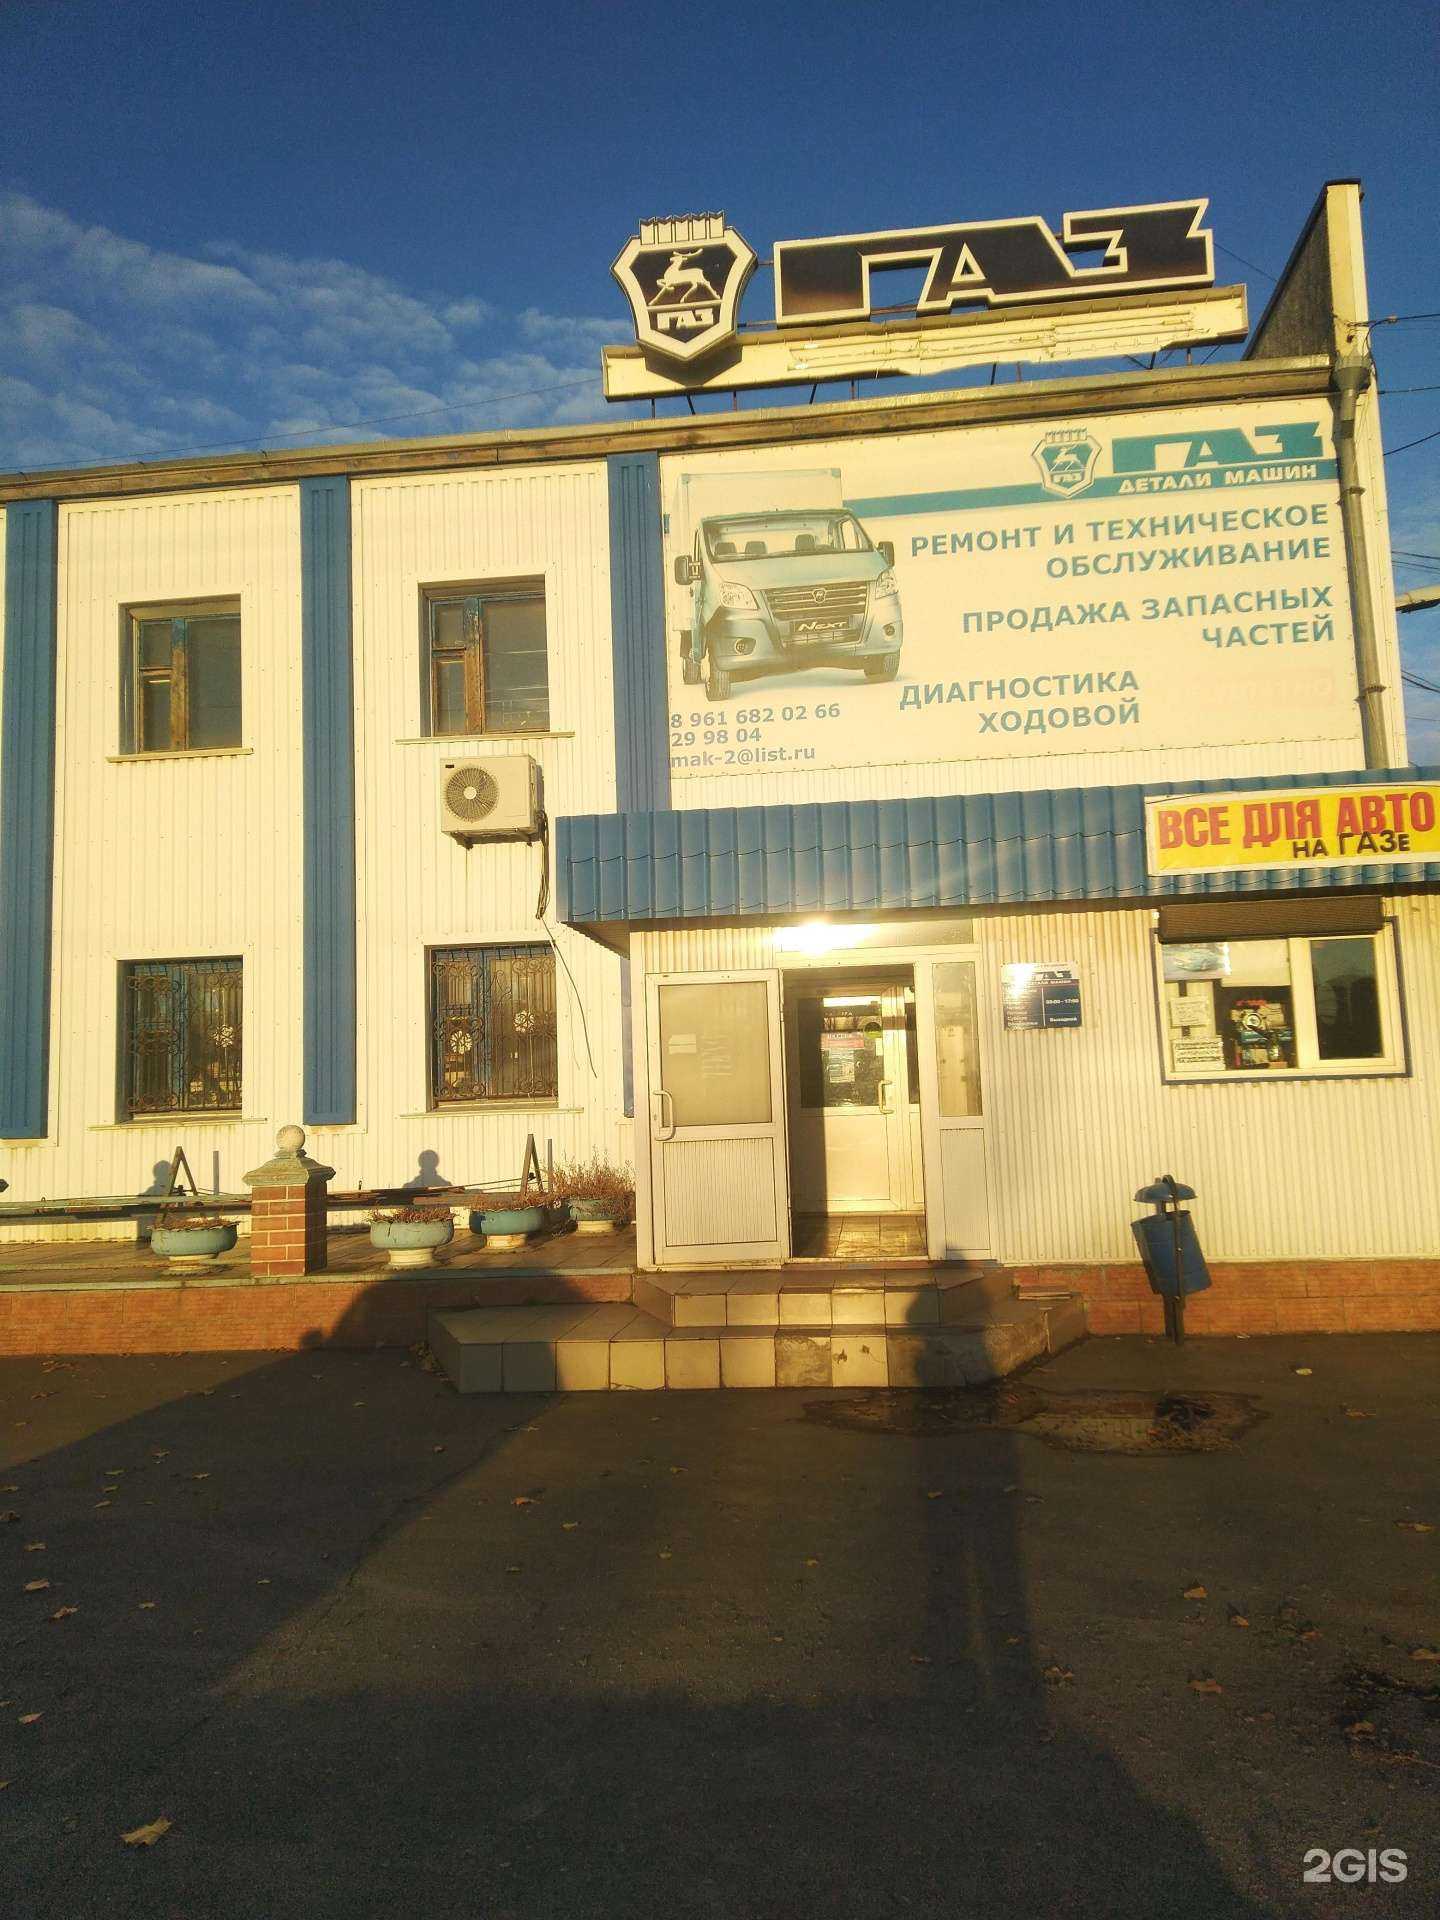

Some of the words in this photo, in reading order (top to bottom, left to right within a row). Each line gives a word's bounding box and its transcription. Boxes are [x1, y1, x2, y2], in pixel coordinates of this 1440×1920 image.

[774, 198, 1214, 328] ГАЗ
[657, 308, 714, 330] ГАЗ
[1112, 421, 1324, 474] ГАЗ
[1118, 474, 1212, 495] ДЕТАЛИ
[1224, 464, 1318, 486] МАШИН
[911, 526, 1042, 557] РЕМОНТ
[1053, 524, 1075, 546] И
[1086, 503, 1329, 543] ТЕХНИЧЕСКОЕ
[1046, 536, 1332, 579] ОБСЛУЖИВАНИЕ
[962, 599, 1131, 634] ПРОДАЖА
[1141, 585, 1334, 620] ЗАПАСНЫХ
[1202, 613, 1336, 649] ЧАСТЕЙ
[899, 670, 1140, 711] ДИАГНОСТИКА
[670, 714, 683, 728] 8
[689, 710, 728, 727] 961
[736, 707, 774, 724] 682
[782, 705, 808, 721] 02
[815, 703, 841, 719] 66
[978, 696, 1141, 735] ХОДОВОЙ
[671, 731, 696, 747] 29
[703, 730, 729, 745] 98
[736, 727, 762, 743] 04
[671, 746, 816, 768] mak-2@list.ru
[1158, 806, 1231, 849] ВСЕ
[1242, 799, 1322, 849] ДЛЯ
[1336, 791, 1435, 836] АВТО
[1293, 838, 1330, 858] НА
[1336, 829, 1411, 855] ГАЗЕ
